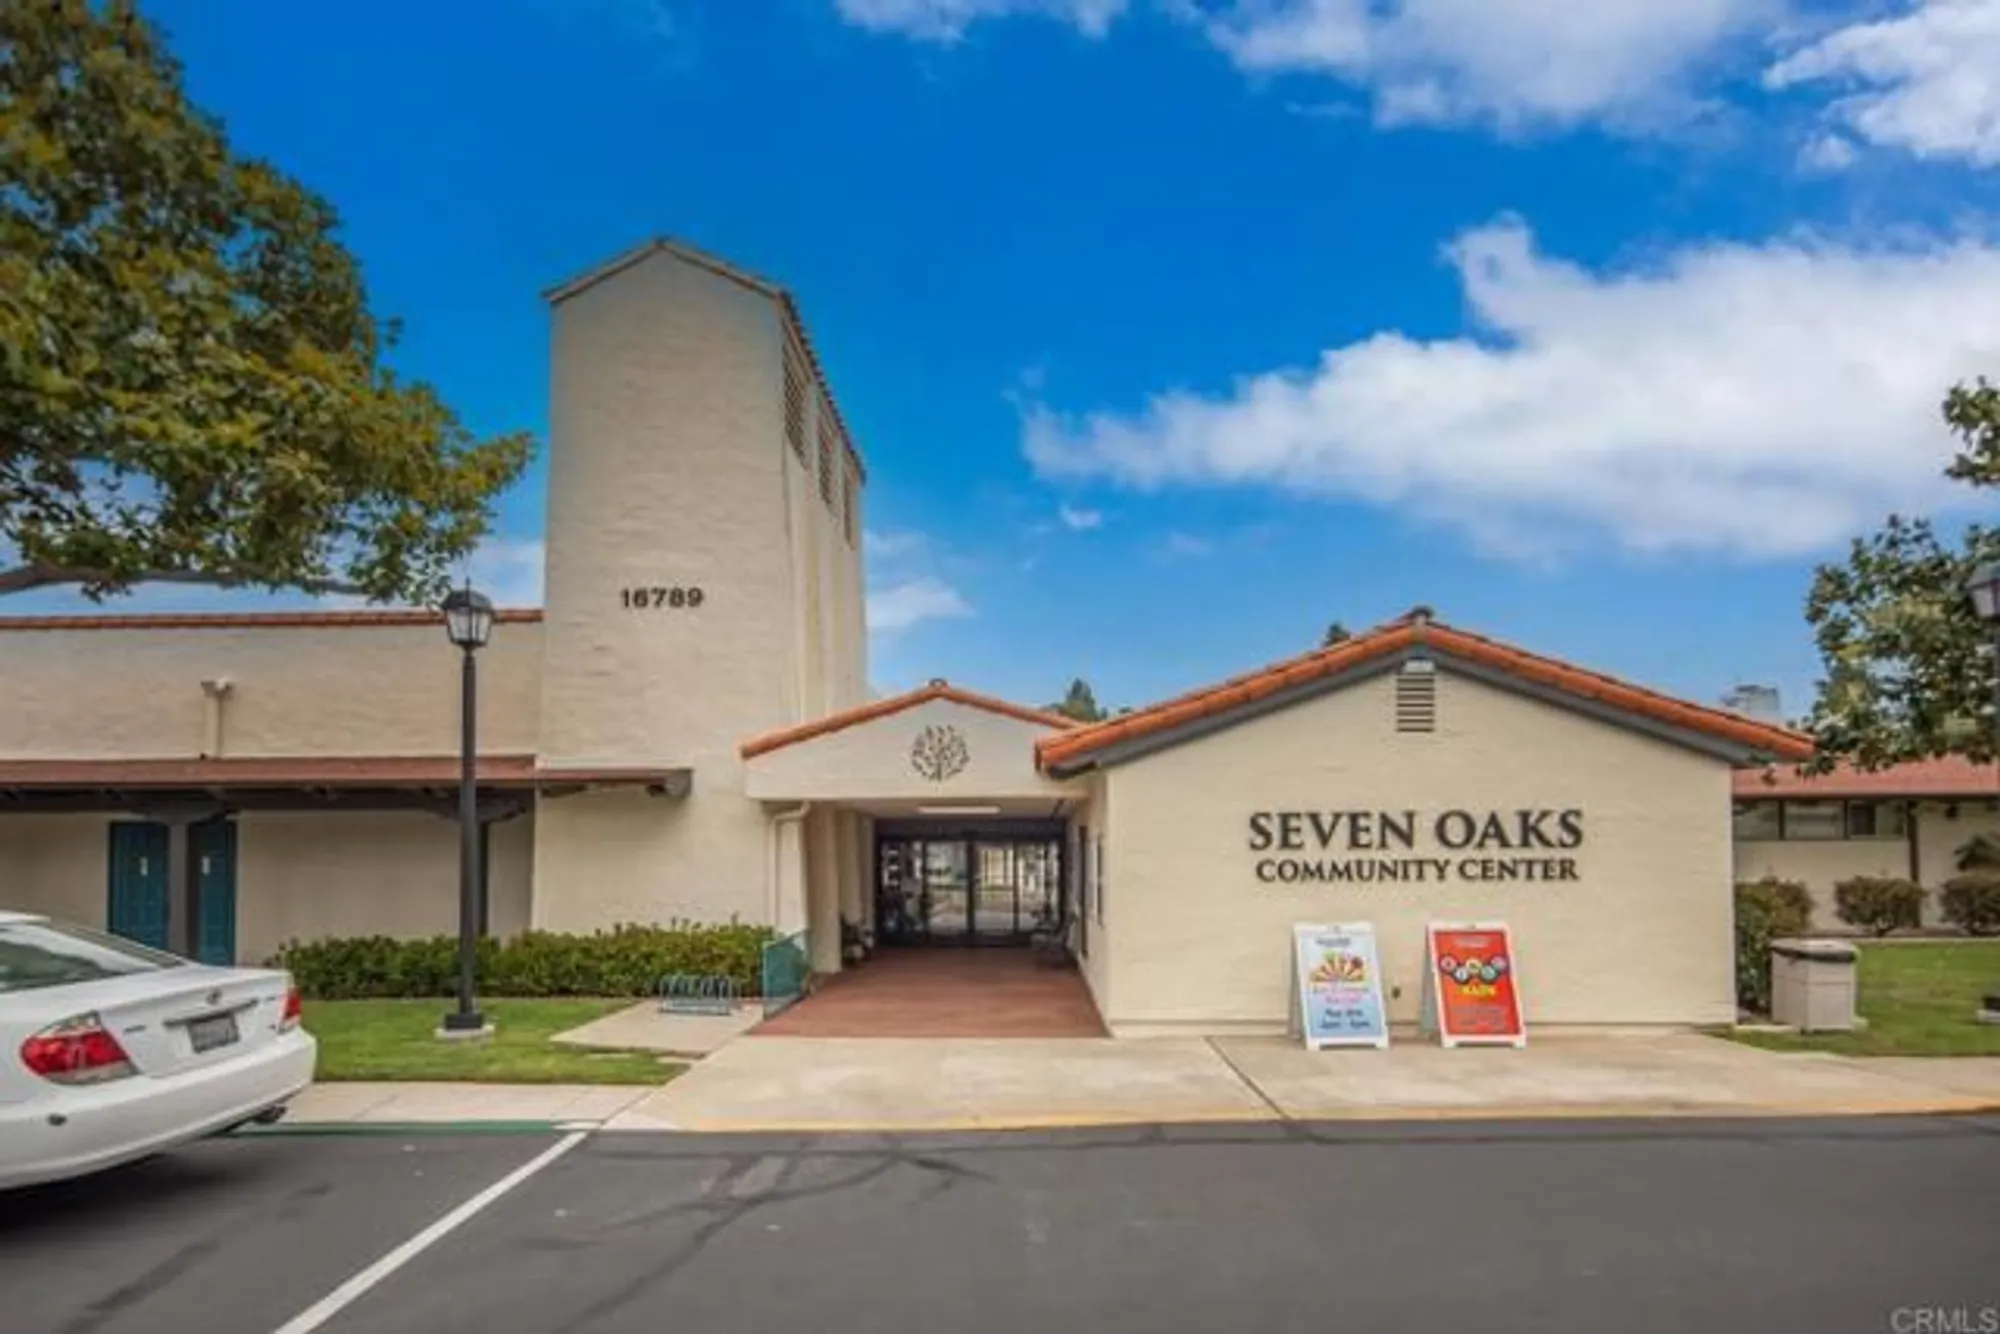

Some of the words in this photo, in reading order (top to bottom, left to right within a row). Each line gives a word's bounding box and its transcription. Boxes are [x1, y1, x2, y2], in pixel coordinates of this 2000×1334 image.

[622, 587, 703, 609] 16789
[1249, 811, 1415, 850] SEVEN
[1434, 810, 1583, 850] OAKS
[1255, 858, 1451, 883] COMMUNITY
[1457, 858, 1580, 882] CENTER
